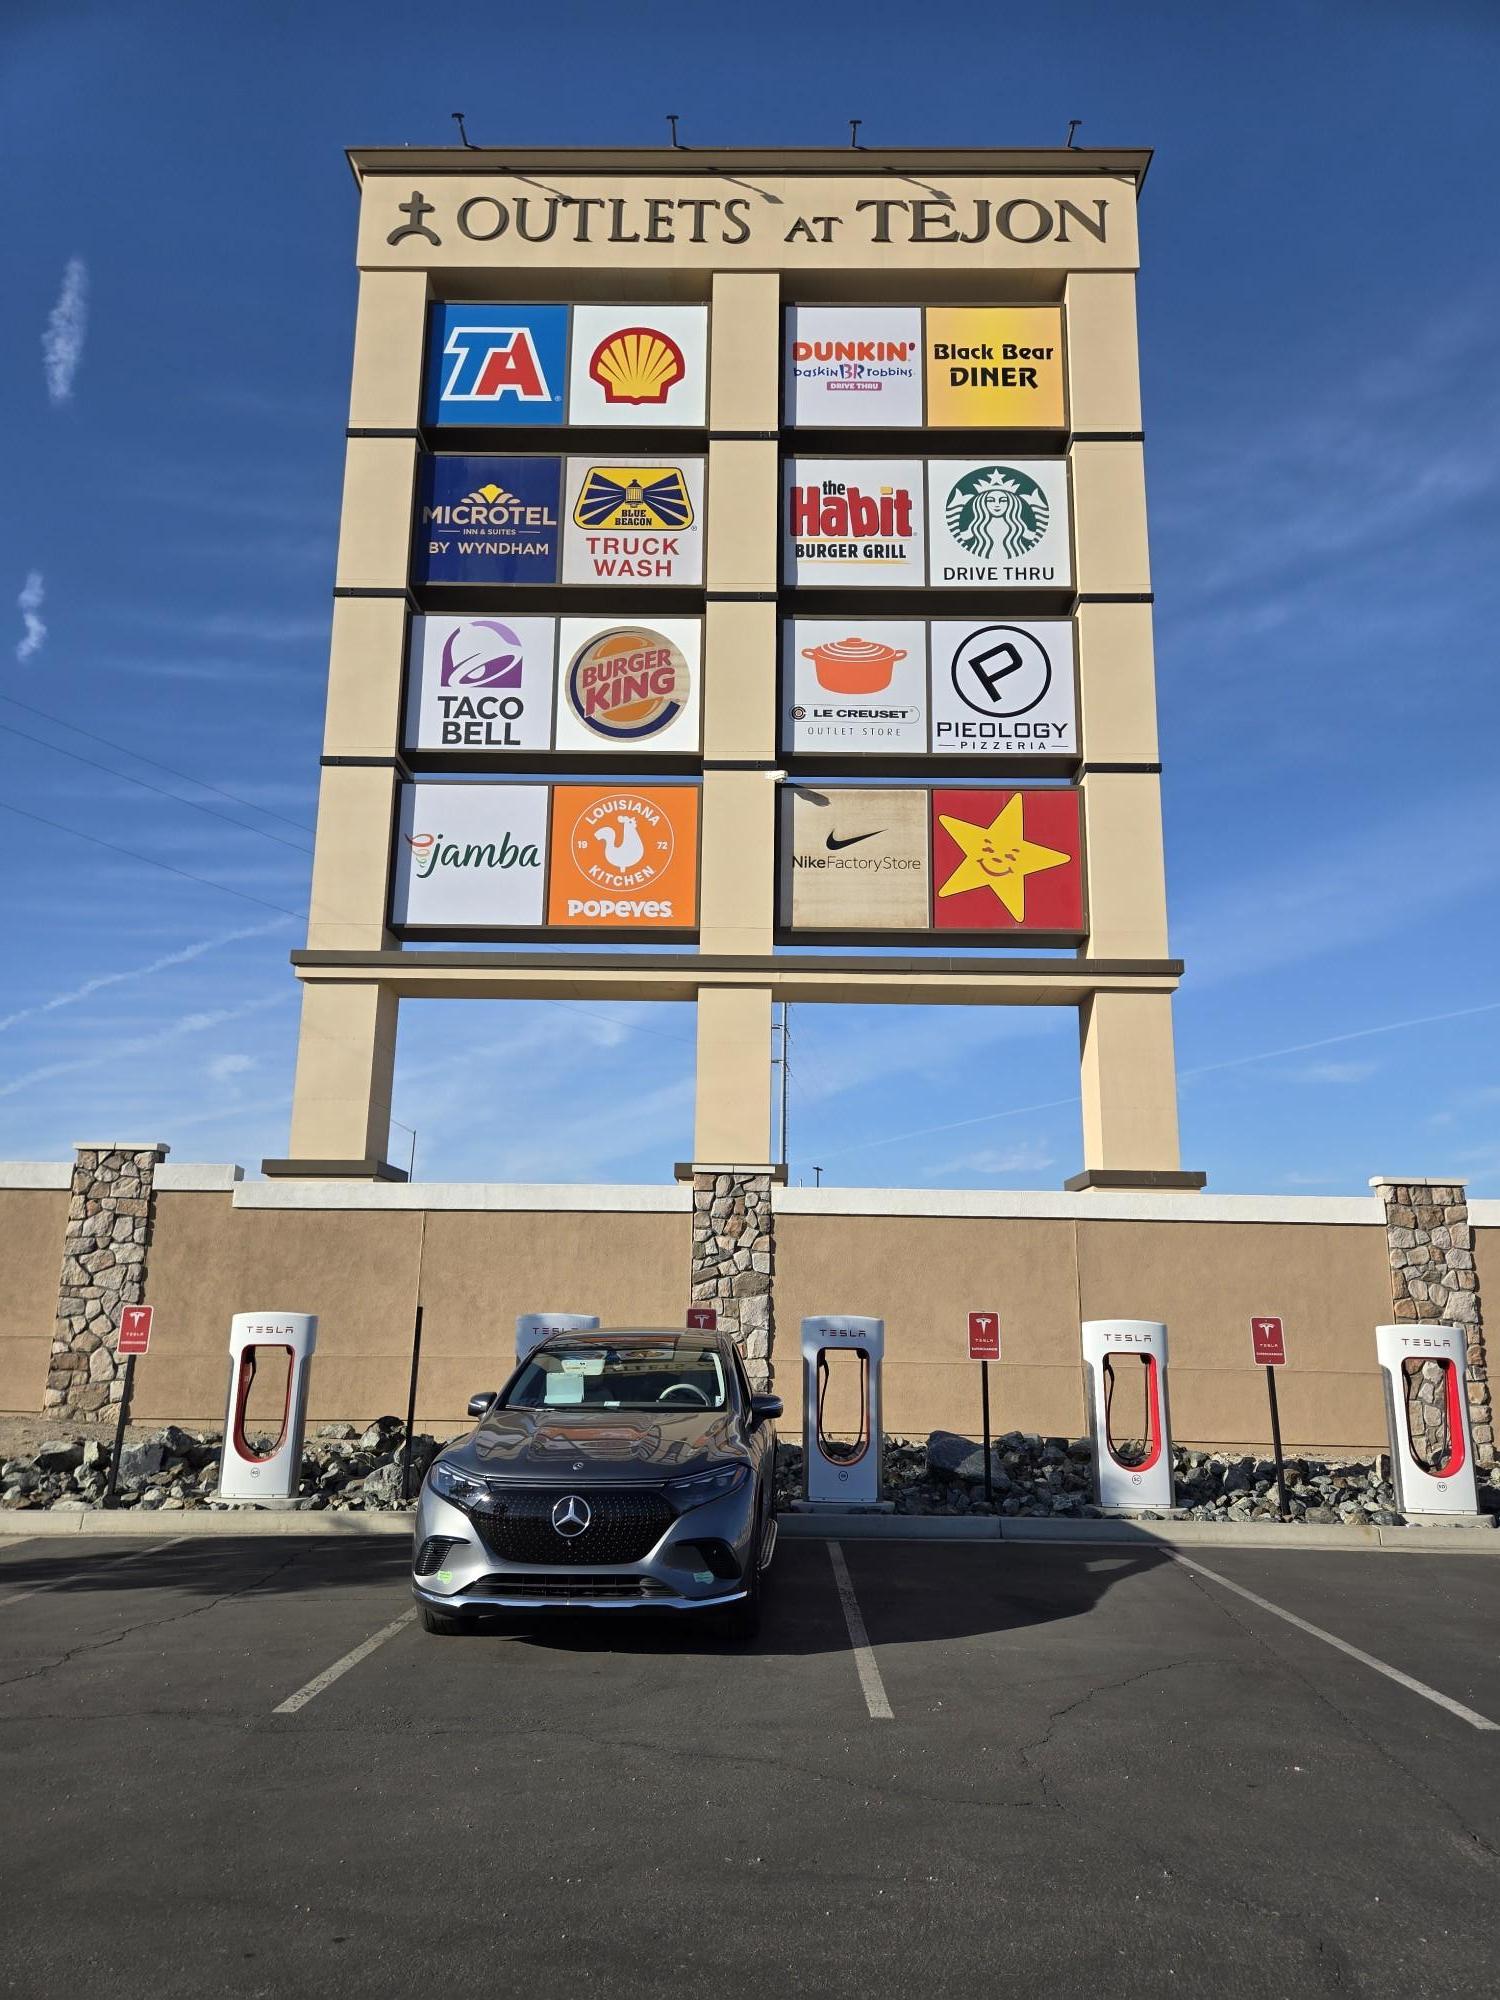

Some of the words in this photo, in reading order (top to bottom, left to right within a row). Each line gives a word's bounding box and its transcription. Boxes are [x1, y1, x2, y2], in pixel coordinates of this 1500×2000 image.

[457, 196, 751, 245] OUTLETS
[784, 216, 844, 243] AT
[856, 199, 1109, 244] TEJON
[792, 341, 916, 362] DUNKIN'
[934, 343, 993, 360] Black
[1002, 343, 1054, 360] Bear
[441, 326, 552, 401] TA
[793, 366, 838, 378] baskin
[867, 367, 912, 378] robbins
[950, 367, 1038, 389] DINER
[822, 480, 846, 496] the
[422, 505, 557, 526] MICROTEL
[789, 486, 913, 537] Habit
[615, 518, 652, 526] BEACON
[488, 528, 517, 536] SUITES
[429, 541, 450, 554] BY
[458, 542, 549, 555] WYNDHAM
[586, 537, 680, 556] TRUCK
[795, 544, 858, 559] BURGER
[863, 544, 907, 559] GRILL
[594, 559, 672, 577] WASH
[943, 567, 998, 581] DRIVE
[1003, 567, 1055, 581] THRU
[582, 648, 672, 688] BURGER
[583, 667, 676, 717] KING
[438, 696, 524, 719] TACO
[813, 709, 833, 718] LE
[836, 709, 908, 719] CREUSET
[442, 721, 521, 745] BELL
[807, 727, 853, 736] OUTLET
[862, 727, 902, 737] STORE
[937, 721, 1069, 739] PIEOLOGY
[960, 741, 1046, 750] PIZZERIA
[585, 799, 660, 827] LOUISIANA
[577, 840, 588, 849] 19
[657, 841, 668, 850] 72
[416, 832, 541, 879] jamba
[588, 864, 656, 887] KITCHEN
[246, 1326, 294, 1334] TESLA
[532, 1327, 578, 1335] TESL
[819, 1329, 867, 1337] TESLA
[1103, 1334, 1152, 1342] TESLA
[1401, 1338, 1451, 1347] TESLA
